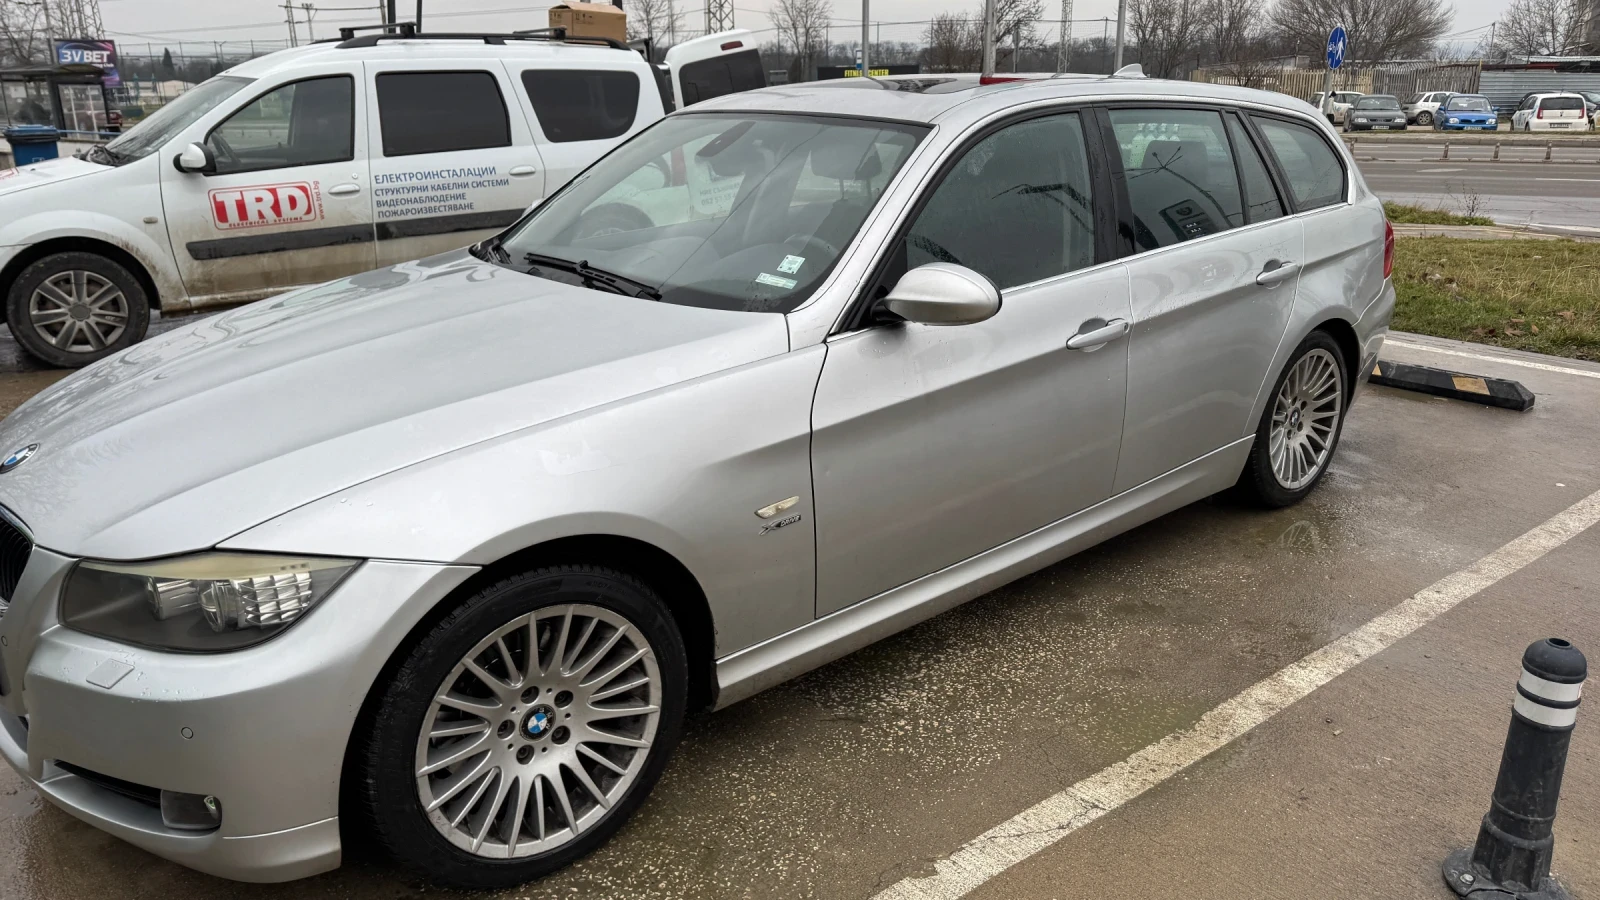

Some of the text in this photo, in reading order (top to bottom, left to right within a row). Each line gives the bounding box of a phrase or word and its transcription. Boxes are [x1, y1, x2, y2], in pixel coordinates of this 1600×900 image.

[374, 166, 496, 185] ЕЛЕКТРОИНСТАЛАЦИИ
[374, 178, 509, 197] СТРУКТУРНИ КАБЕЛНИ СИСТЕМИ
[213, 186, 309, 223] TRD
[313, 181, 325, 220] www.trd.bg
[376, 192, 467, 208] ВИДЕОНАБЛЮДЕНИЕ
[377, 202, 475, 218] ПОЖАРОИЗВЕСТЯВАНЕ
[228, 215, 303, 228] ELECTRICAL SYSTEMS
